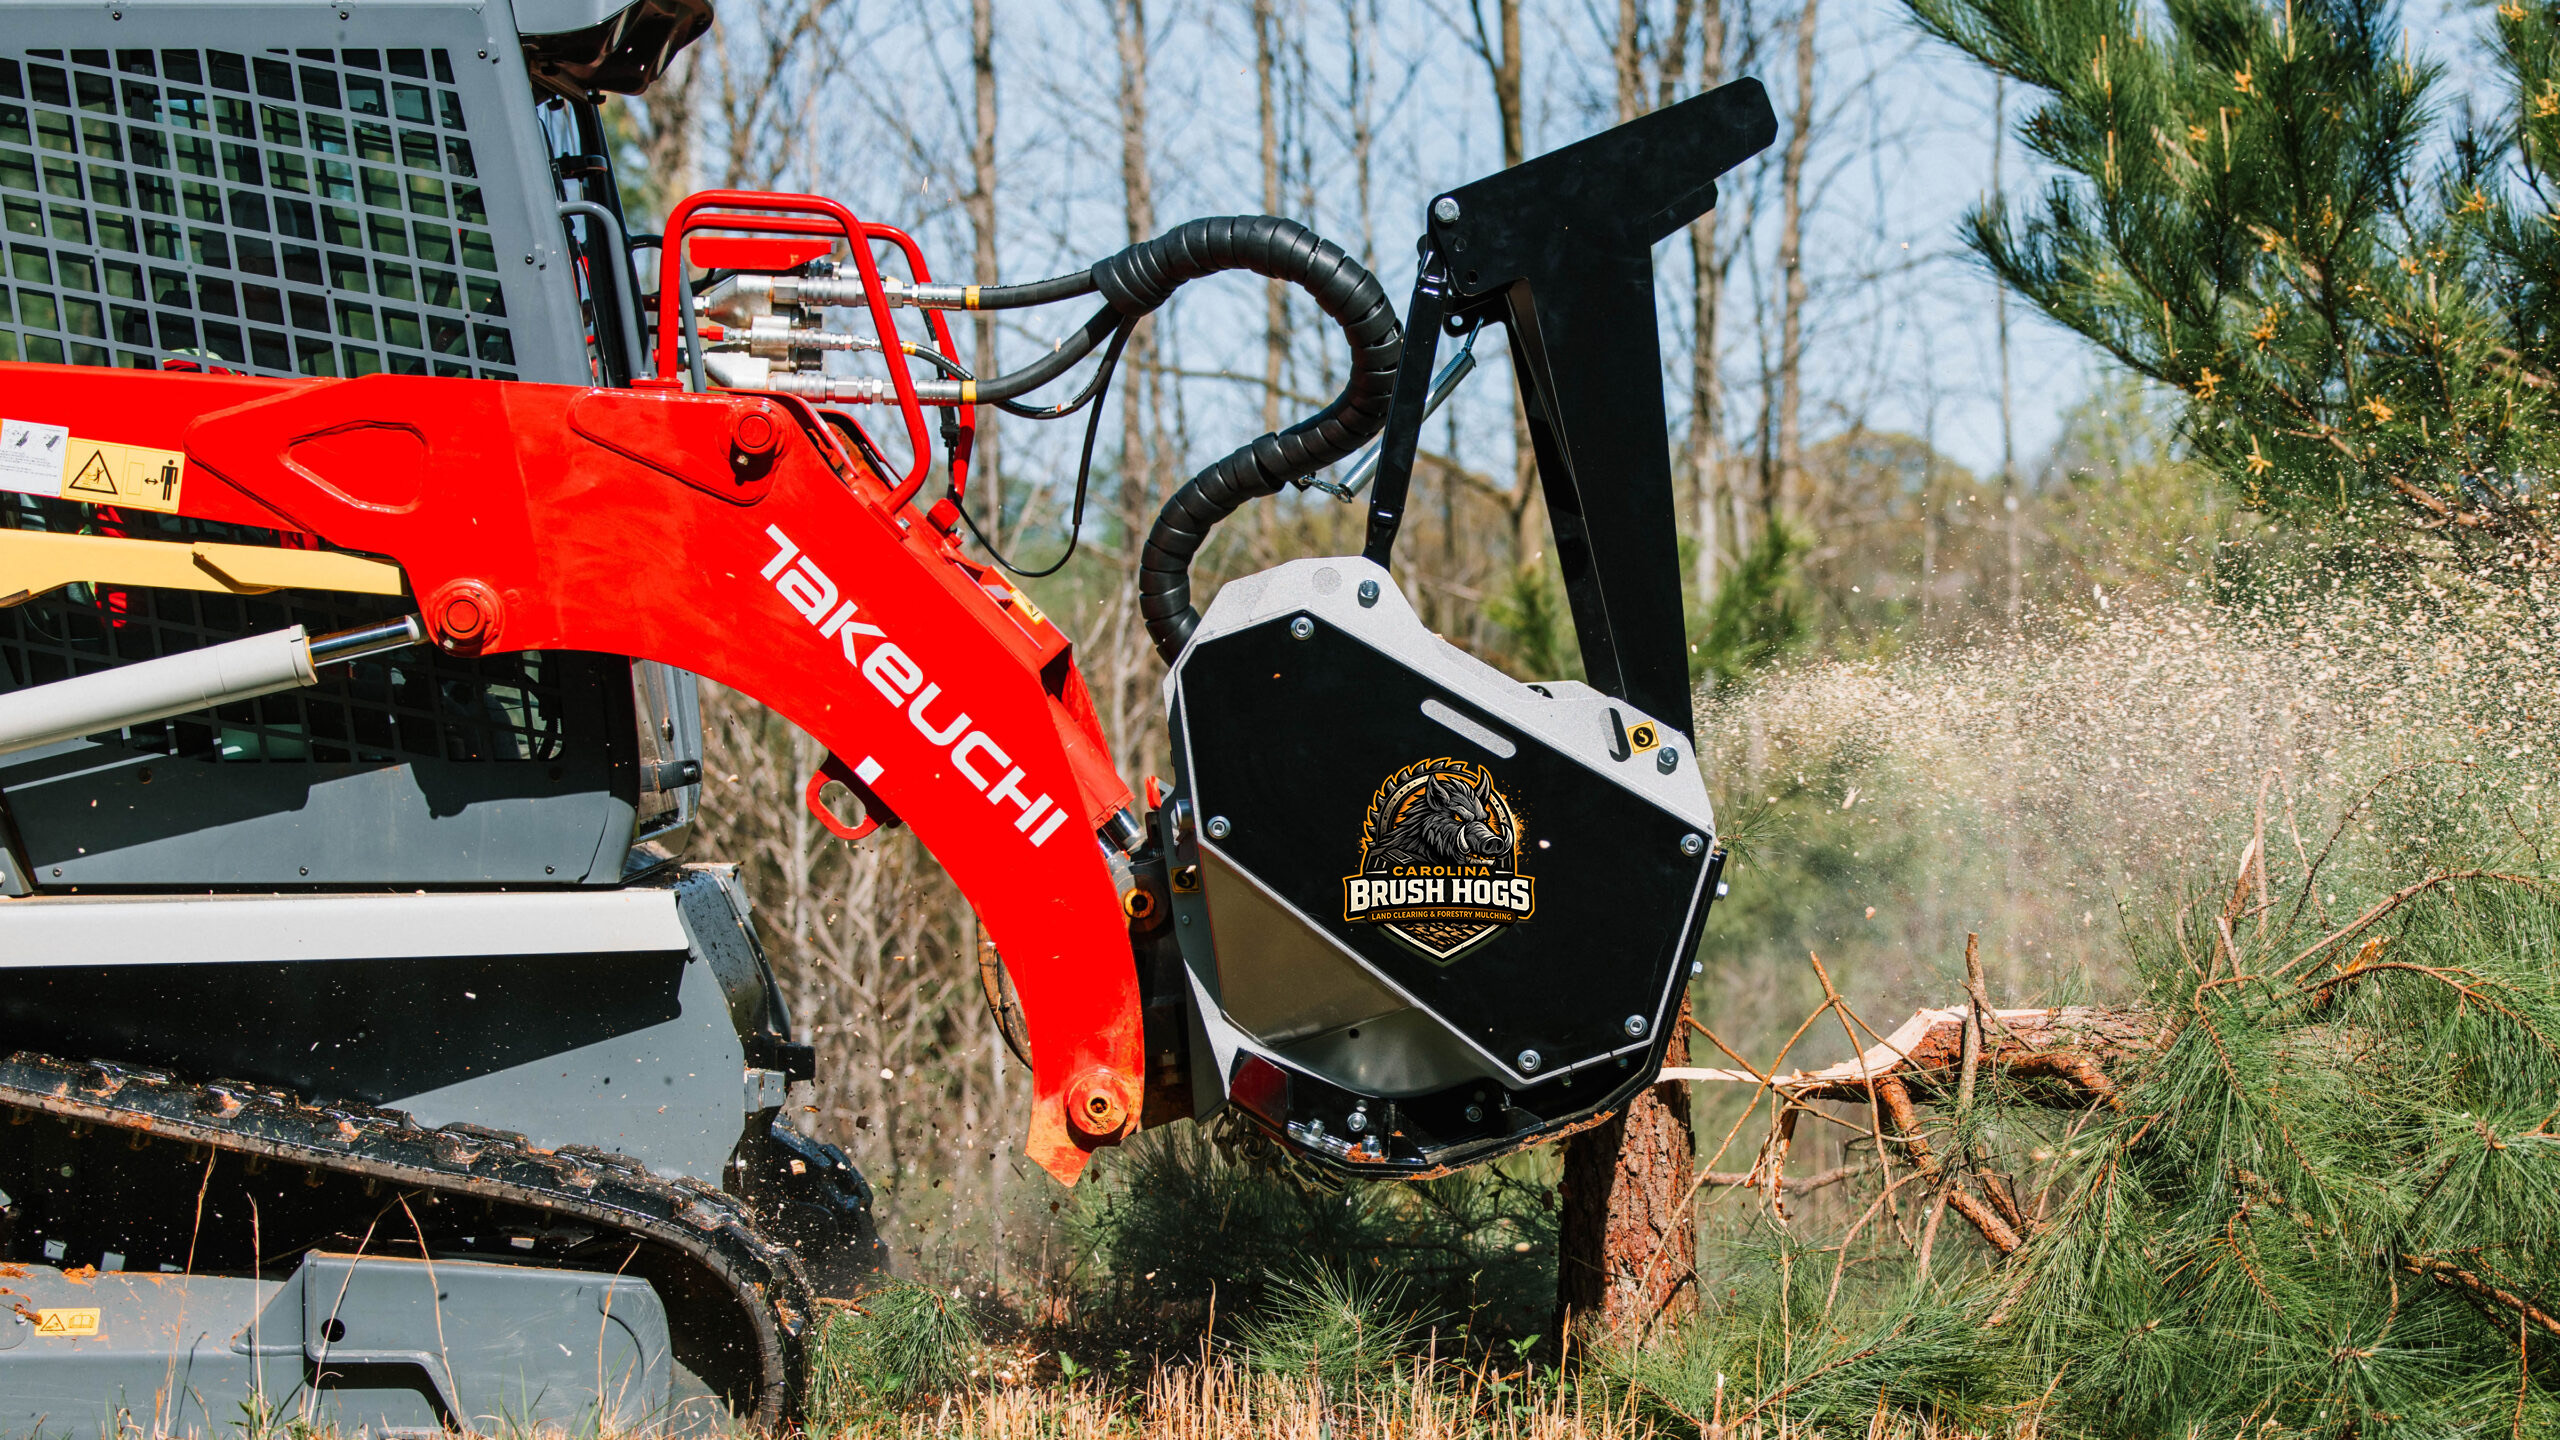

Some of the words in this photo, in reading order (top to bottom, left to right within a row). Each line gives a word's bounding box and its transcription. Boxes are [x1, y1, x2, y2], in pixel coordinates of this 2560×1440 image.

[1393, 866, 1490, 876] CAROLINA
[1350, 879, 1445, 912] BRUSH
[1451, 879, 1530, 911] HOGS
[1371, 912, 1392, 920] LAND
[1393, 911, 1429, 919] CLEARING
[1474, 912, 1512, 920] MULCHING
